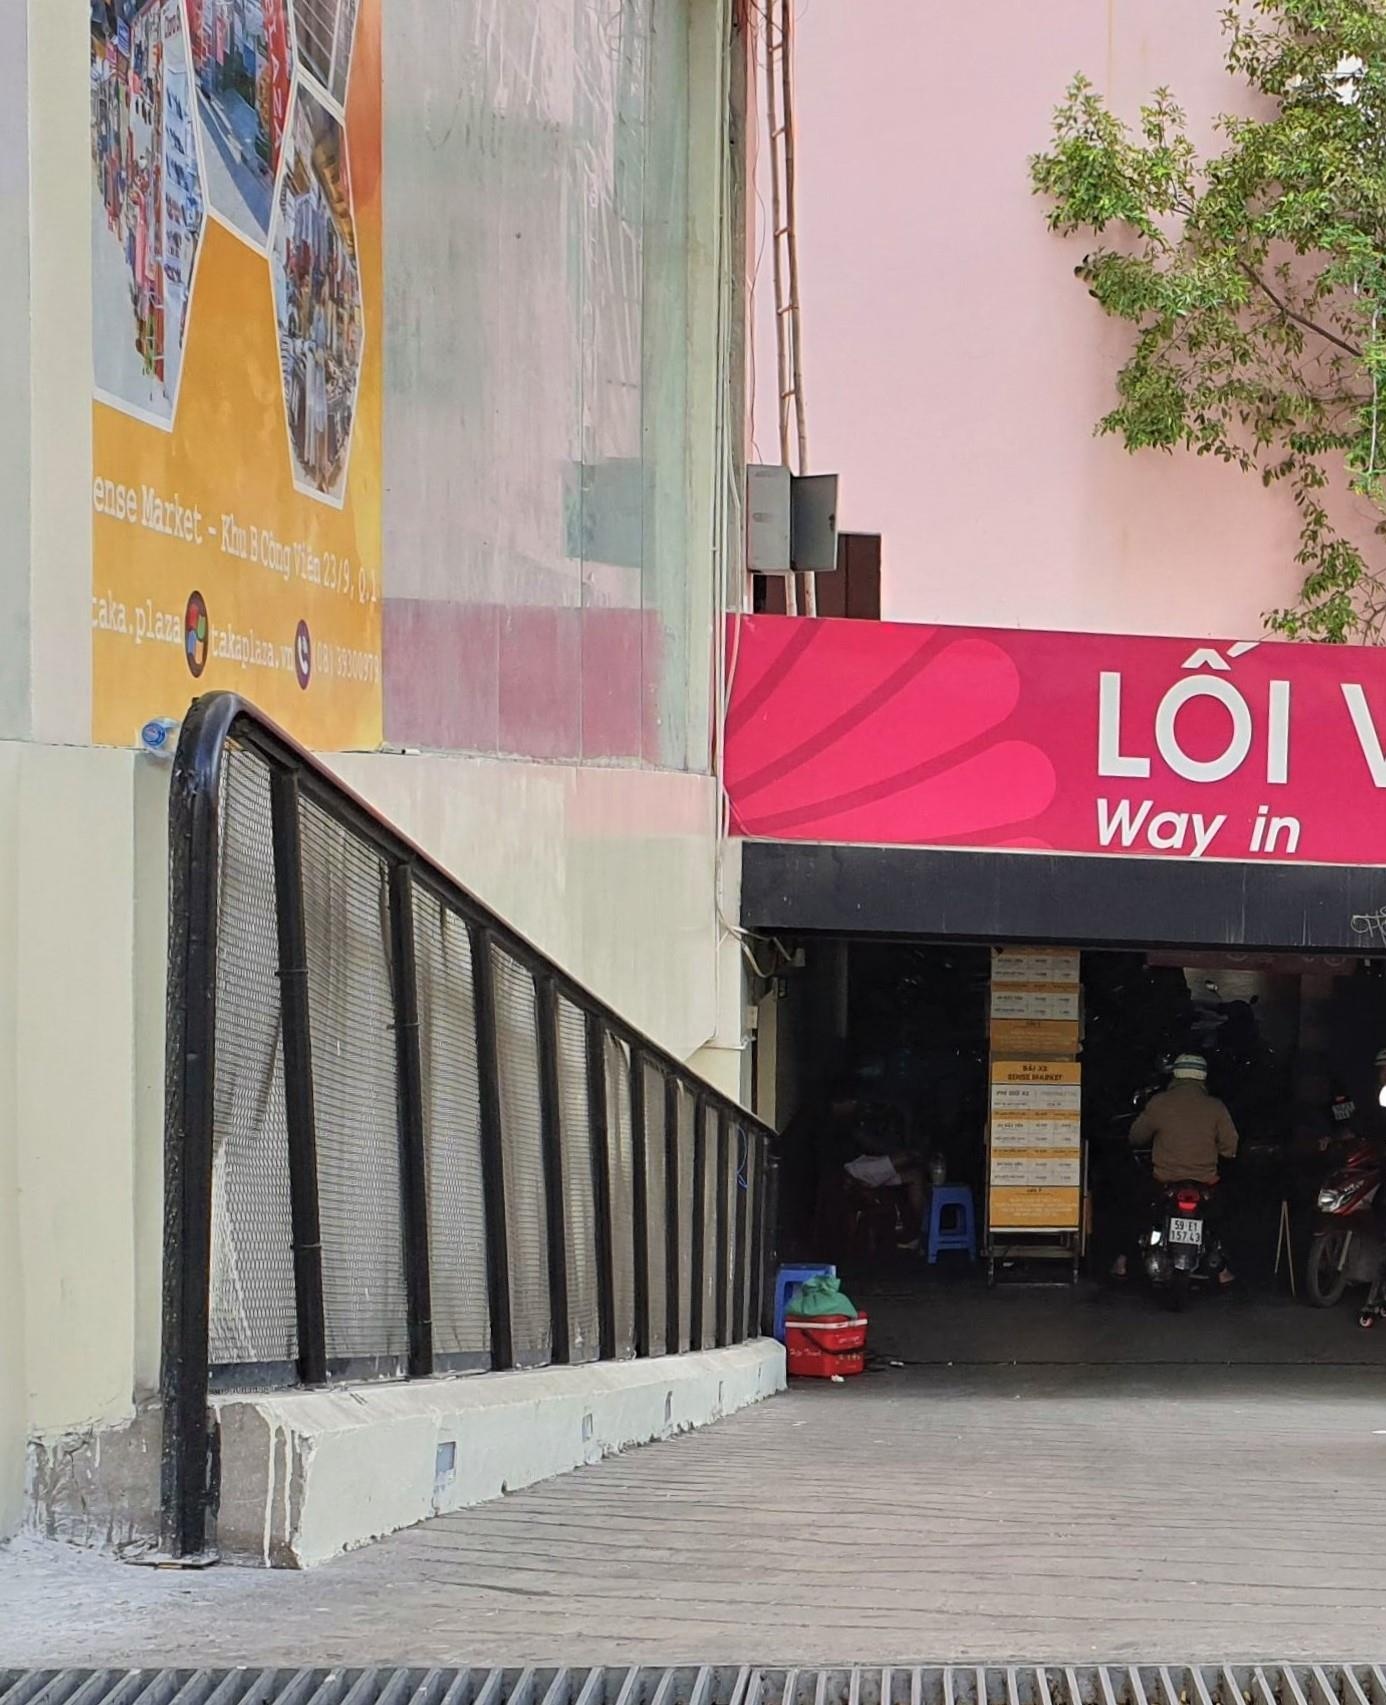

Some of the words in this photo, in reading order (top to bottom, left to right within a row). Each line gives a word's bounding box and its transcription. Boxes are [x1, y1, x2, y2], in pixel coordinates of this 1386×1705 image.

[141, 484, 203, 544] Market
[249, 525, 258, 562] B
[1098, 641, 1290, 784] LỐI
[1097, 799, 1224, 857] Way
[1249, 804, 1301, 854] in
